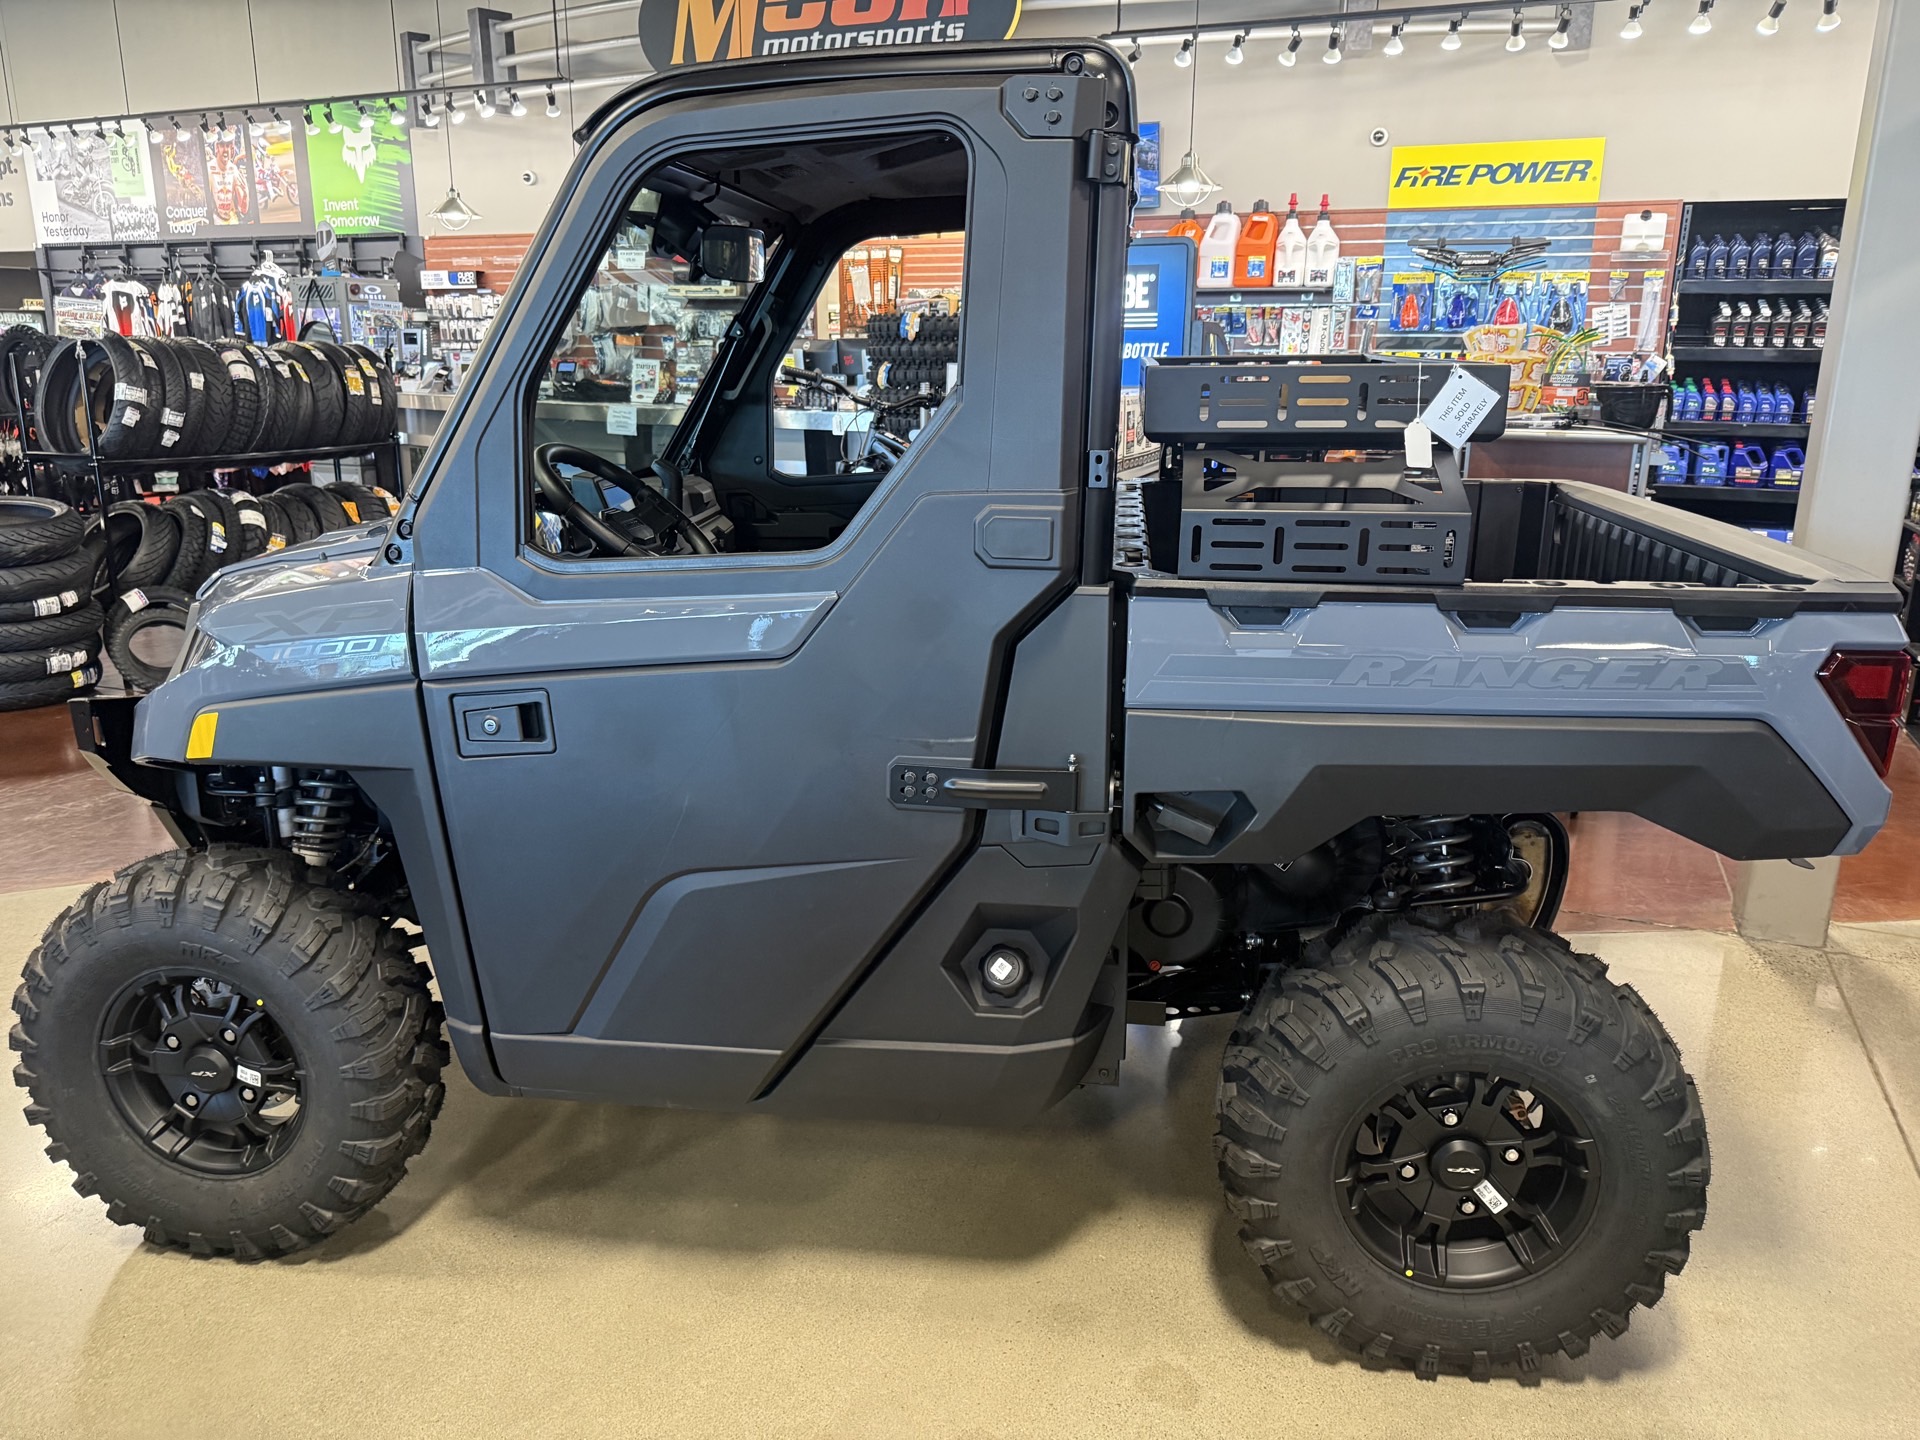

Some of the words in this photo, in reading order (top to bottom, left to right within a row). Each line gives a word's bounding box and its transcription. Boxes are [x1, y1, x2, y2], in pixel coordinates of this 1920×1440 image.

[1394, 164, 1471, 188] FIRE
[1466, 159, 1593, 186] POWER
[323, 198, 359, 212] Invent
[41, 211, 69, 223] Honor
[166, 206, 207, 222] Conquer
[325, 214, 380, 228] Tomorrow
[43, 225, 90, 239] Yesterday
[167, 219, 197, 236] Today
[1122, 342, 1170, 359] BOTTLE
[1439, 405, 1454, 422] THIS
[1451, 387, 1468, 407] ITEM
[1454, 402, 1471, 421] SOLD
[1455, 398, 1489, 438] SEPARATELY
[1335, 655, 1723, 690] RANGER
[1447, 1033, 1539, 1058] ARMOR
